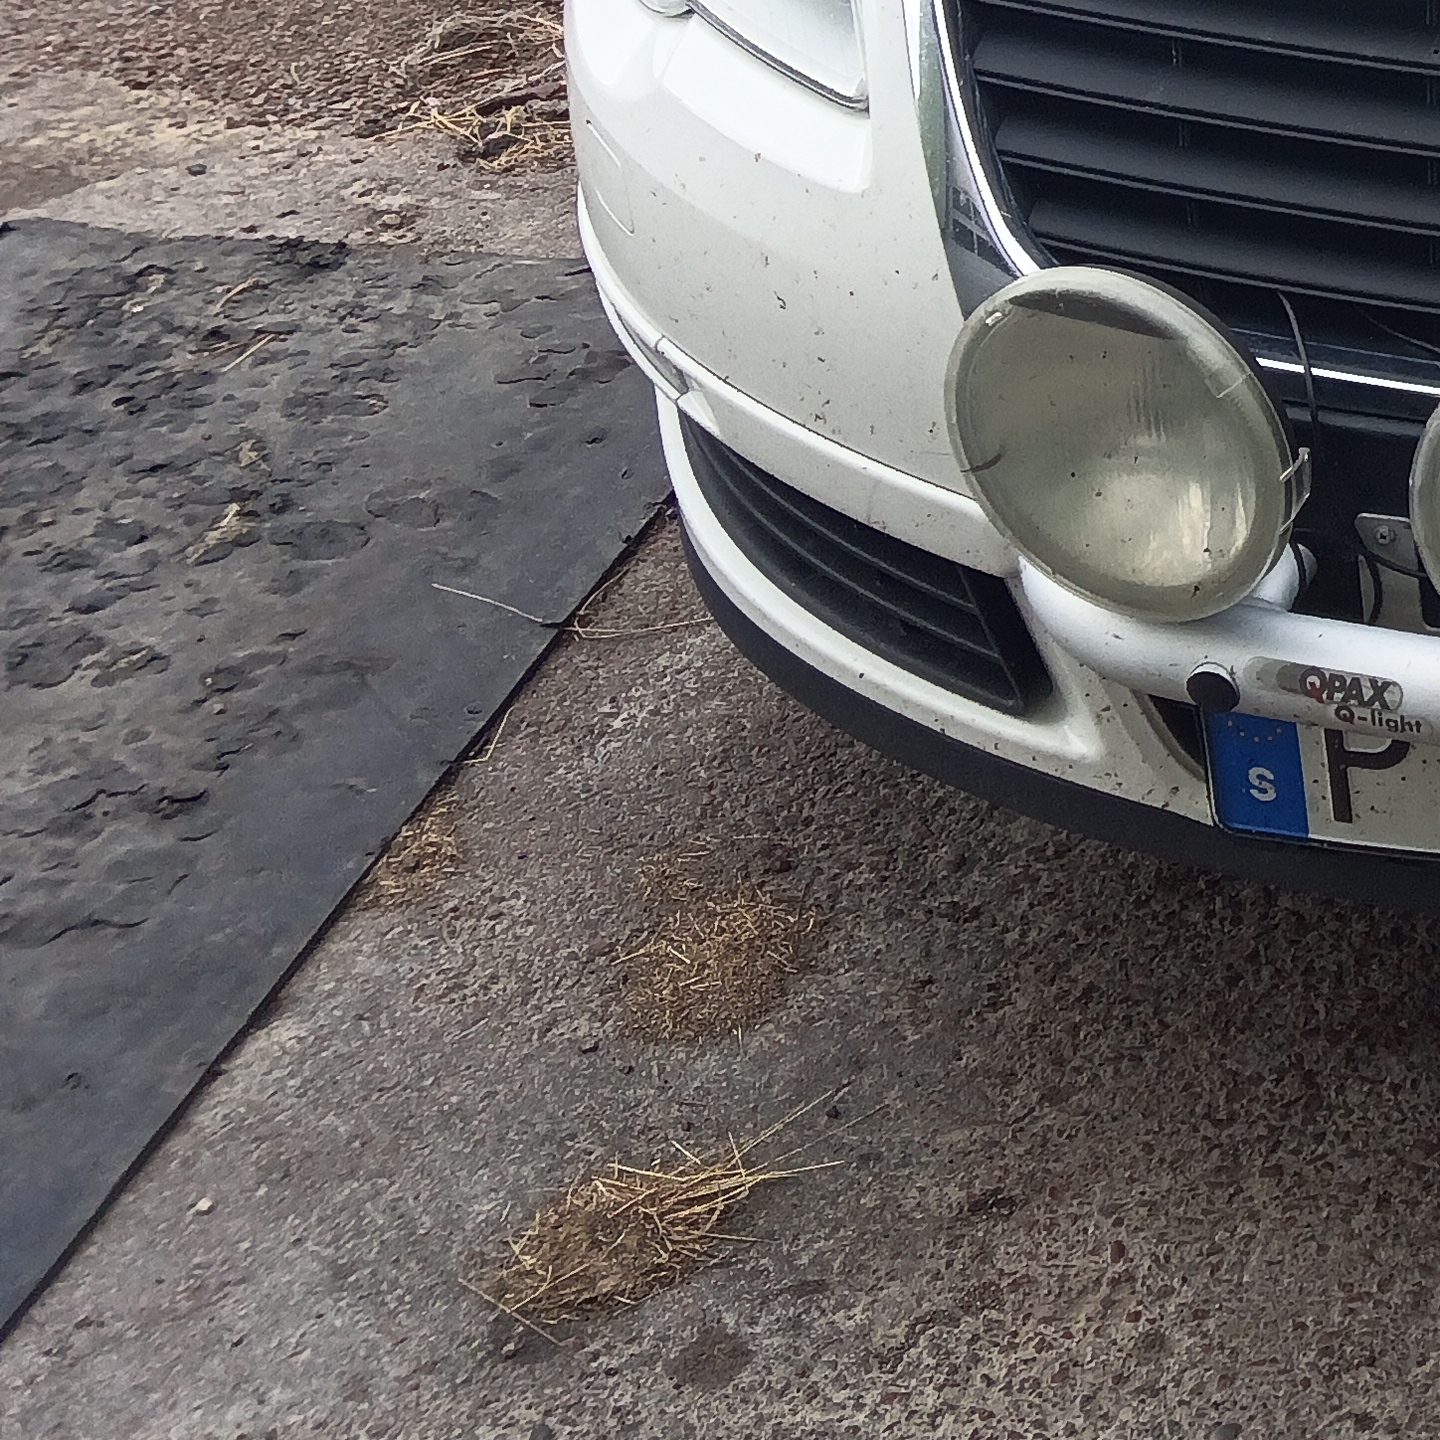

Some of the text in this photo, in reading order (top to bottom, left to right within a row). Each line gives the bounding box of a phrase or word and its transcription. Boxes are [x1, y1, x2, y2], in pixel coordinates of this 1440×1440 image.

[1299, 666, 1392, 711] QPAX
[1334, 704, 1422, 734] Q-light
[1248, 766, 1278, 802] S
